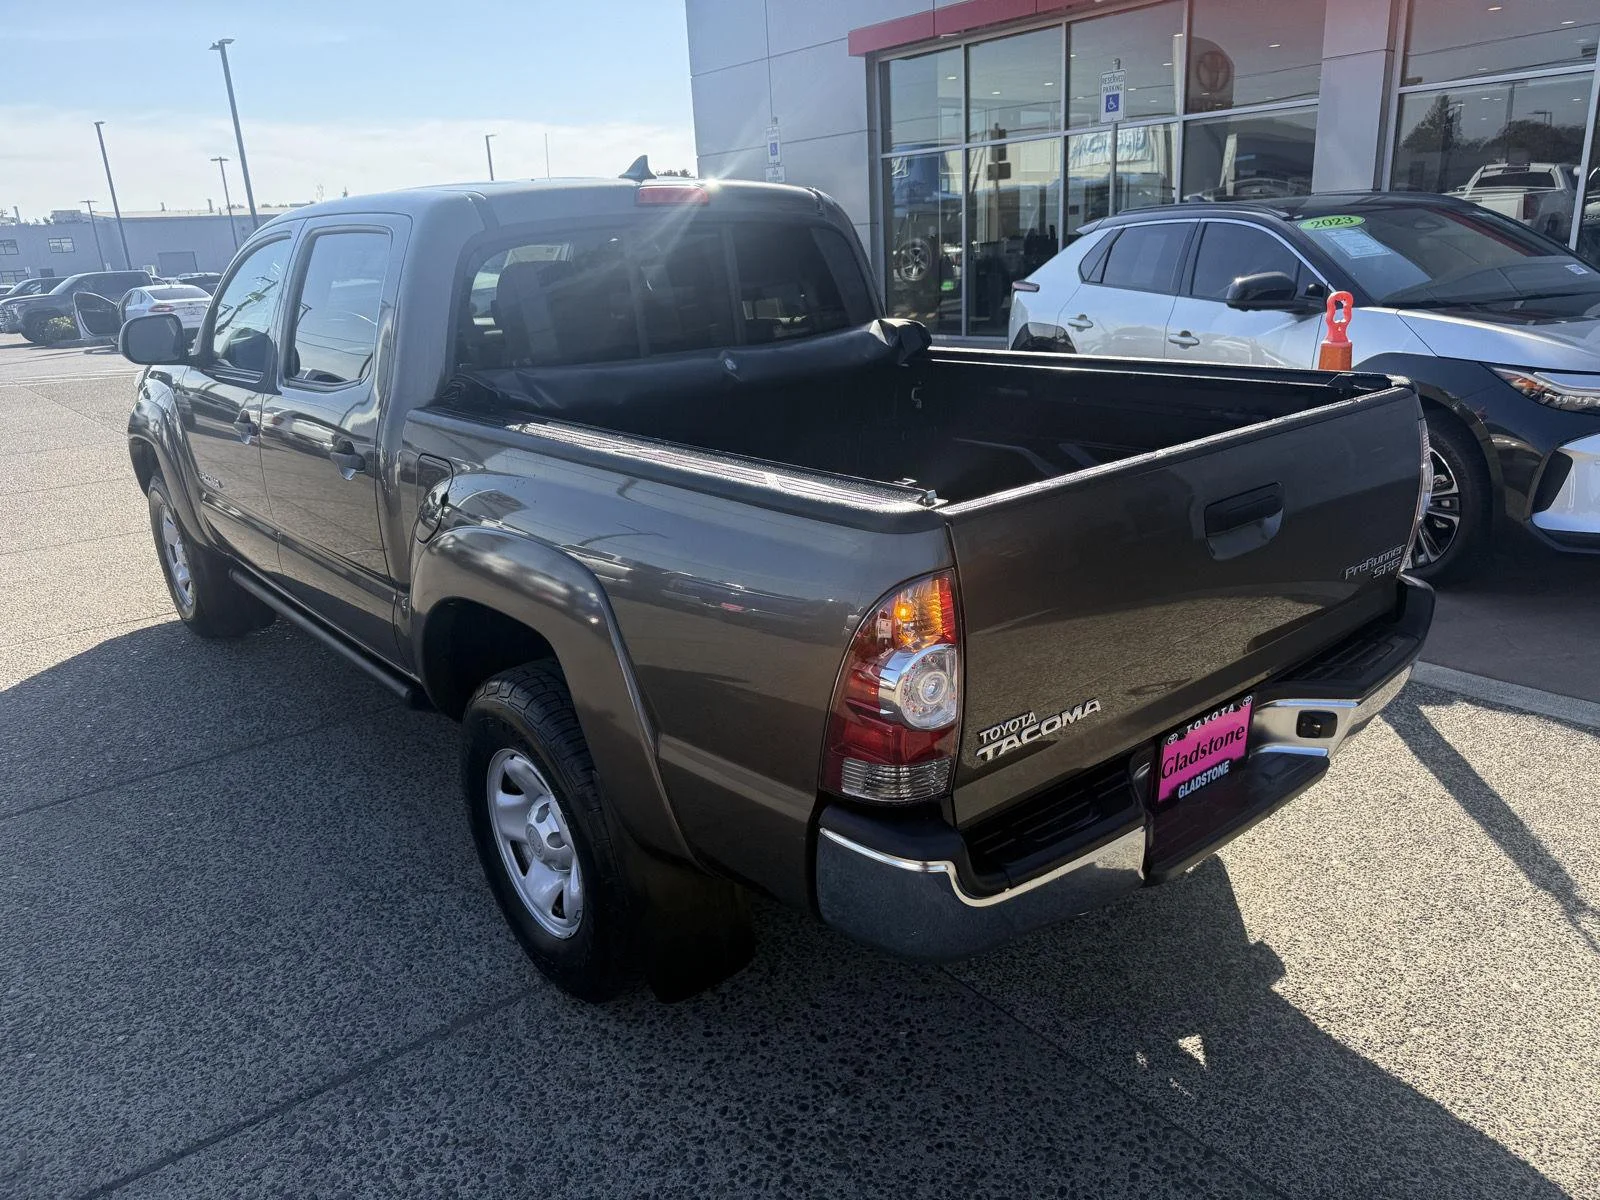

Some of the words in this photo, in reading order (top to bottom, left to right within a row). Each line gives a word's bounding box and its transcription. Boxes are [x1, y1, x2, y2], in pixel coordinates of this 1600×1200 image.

[1102, 83, 1123, 93] PARKING
[1311, 216, 1354, 229] 2023
[976, 698, 1101, 761] TACOMA
[980, 711, 1037, 744] TOYOTA
[1186, 703, 1235, 733] TOYOTA
[1161, 725, 1246, 779] Gladstone
[1178, 760, 1230, 799] GLADSTONE
